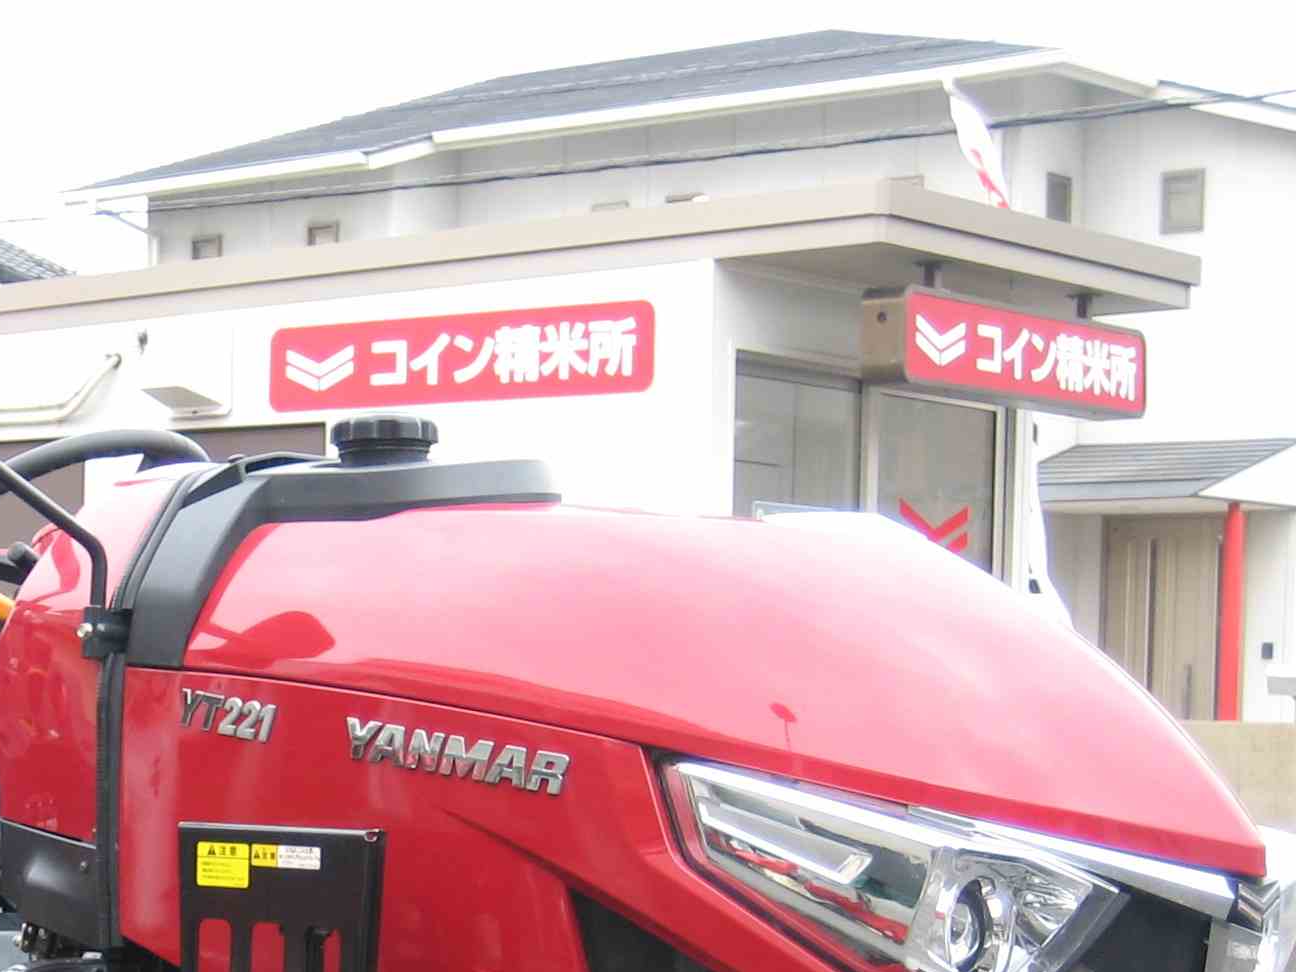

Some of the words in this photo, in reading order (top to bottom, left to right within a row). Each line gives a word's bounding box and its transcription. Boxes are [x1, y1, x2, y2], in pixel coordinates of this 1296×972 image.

[370, 317, 637, 386] コイン精米所
[975, 322, 1137, 401] コイン精米所
[181, 688, 278, 743] YT221
[346, 716, 571, 795] YANMAR
